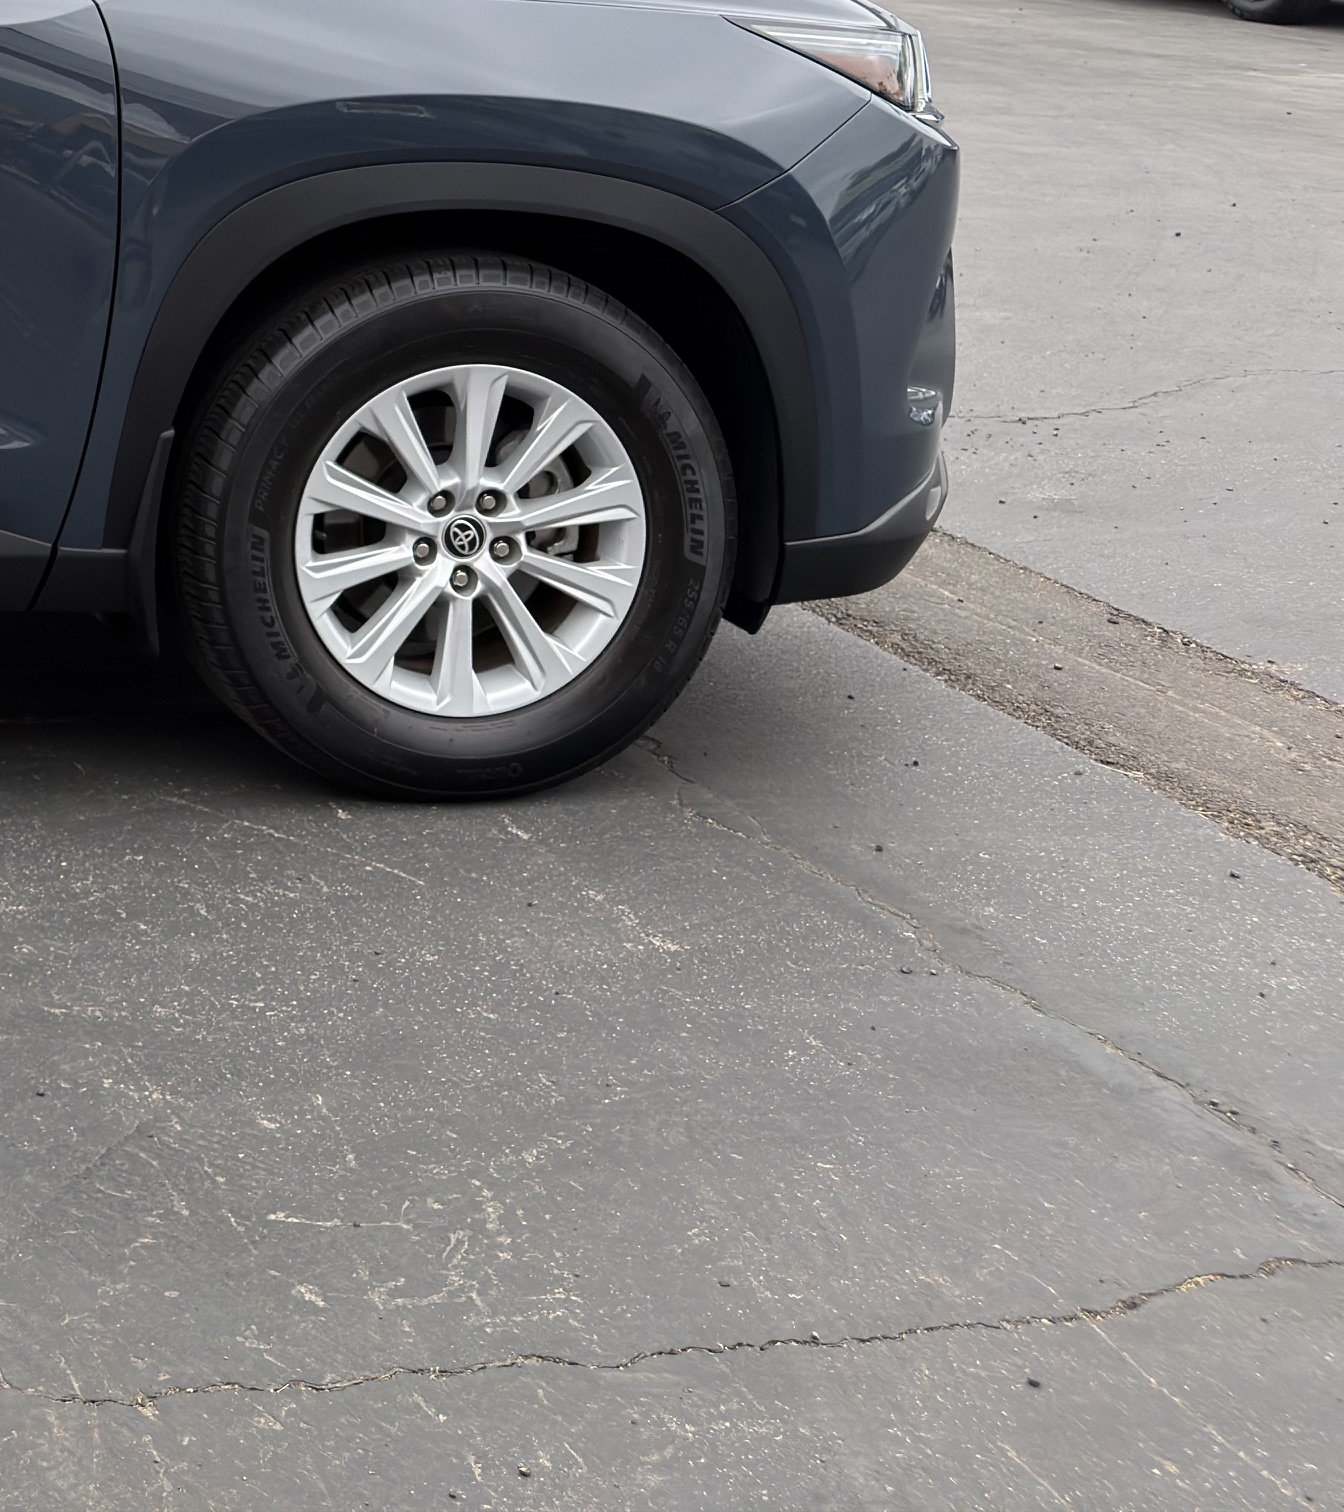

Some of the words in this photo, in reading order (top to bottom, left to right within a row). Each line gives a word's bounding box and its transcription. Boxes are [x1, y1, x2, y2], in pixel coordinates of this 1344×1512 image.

[254, 434, 292, 512] PRIMACY
[665, 431, 705, 557] MICHELIN
[250, 533, 291, 662] MICHELIN
